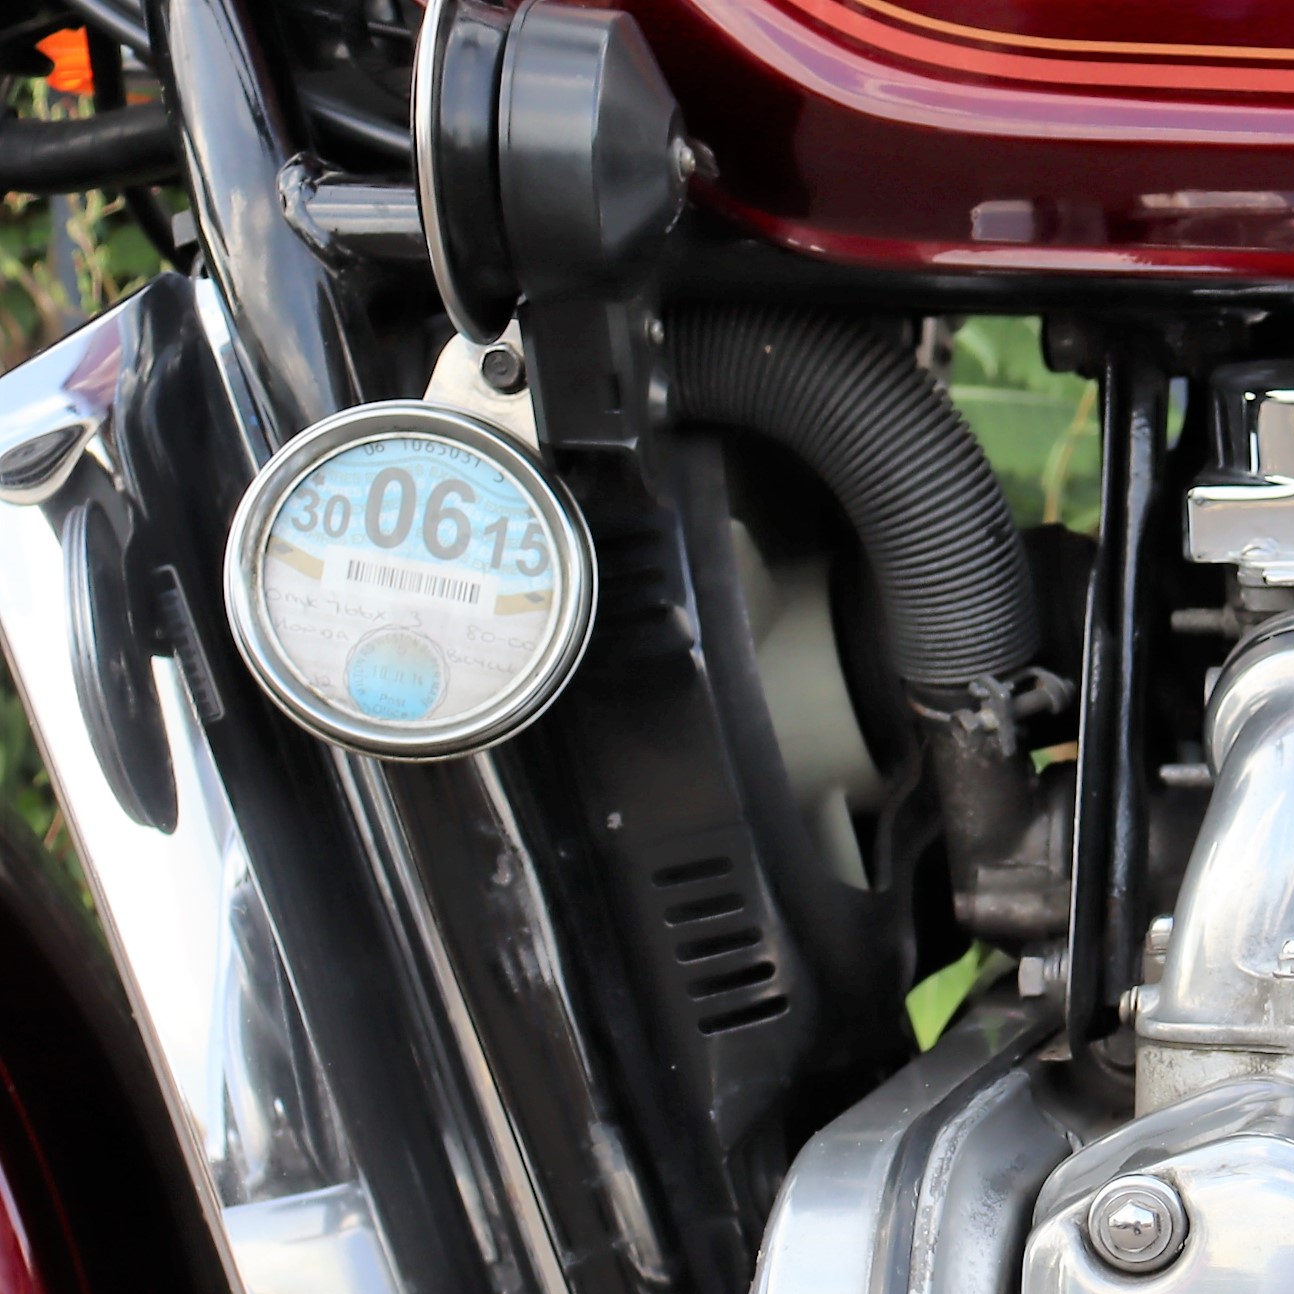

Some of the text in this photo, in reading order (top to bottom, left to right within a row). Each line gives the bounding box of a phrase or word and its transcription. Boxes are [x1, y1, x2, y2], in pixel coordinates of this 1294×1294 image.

[291, 467, 551, 577] 30 06 15
